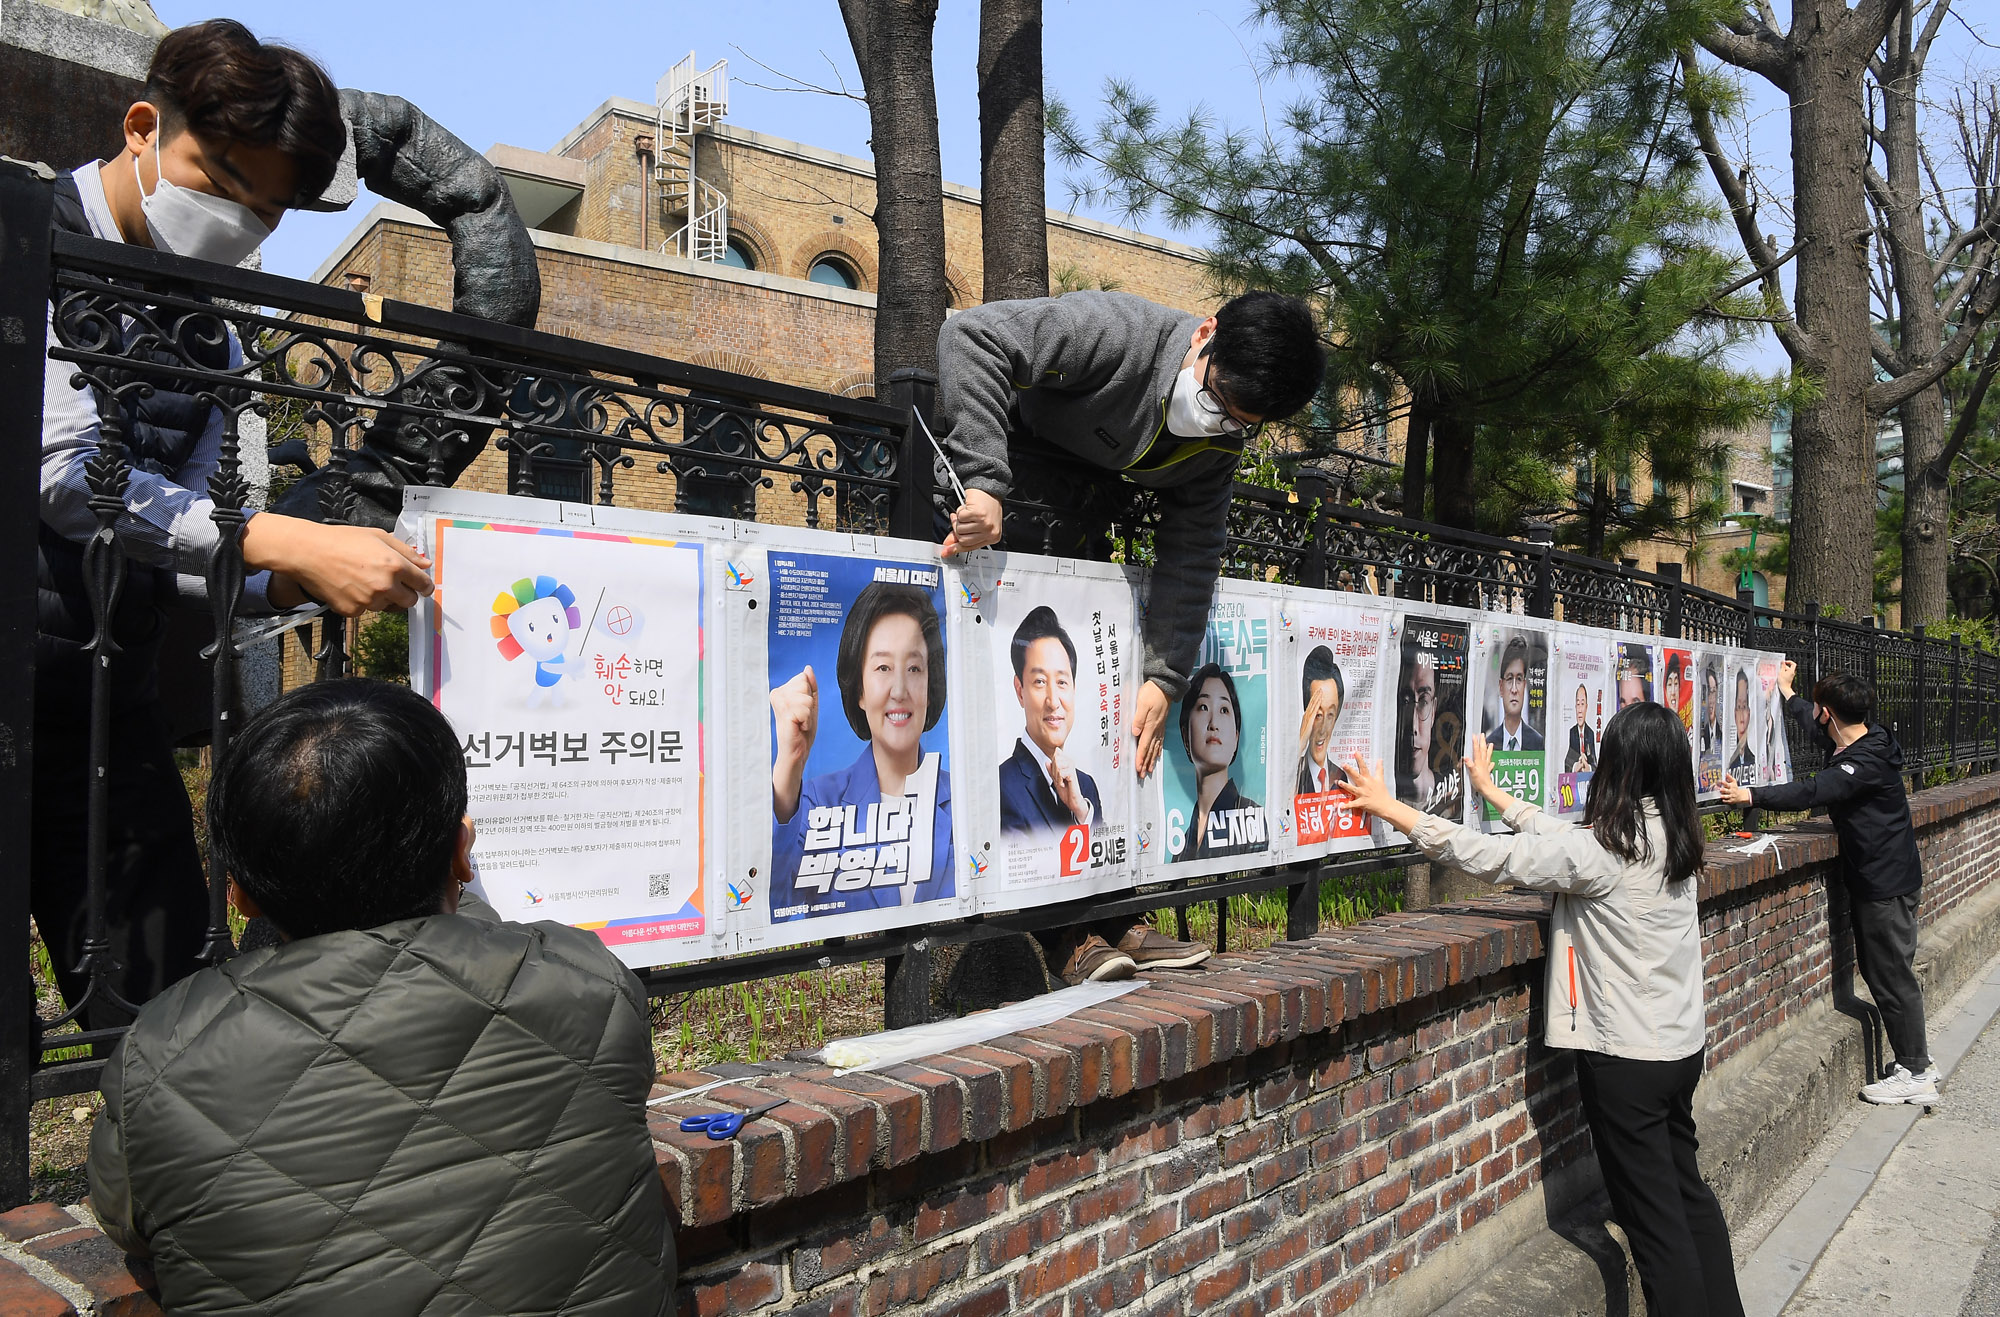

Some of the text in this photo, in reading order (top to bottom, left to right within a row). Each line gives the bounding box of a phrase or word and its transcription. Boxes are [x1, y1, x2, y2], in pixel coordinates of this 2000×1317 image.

[873, 566, 910, 584] 서울시
[1308, 626, 1379, 644] 국가에 돈이 없는 것이 아니라
[1416, 630, 1439, 648] 서울은
[1107, 623, 1121, 687] 서울부터
[1335, 643, 1377, 657] 도둑놈이 많습니다
[594, 652, 663, 680] 훼손하면
[1417, 652, 1439, 670] 이기는
[1092, 610, 1109, 748] 첫날부터 능숙하게
[604, 684, 665, 706] 안 돼요!
[463, 729, 684, 768] 선거벽보 주의문
[474, 783, 508, 792] 선거벽보는
[551, 781, 559, 789] 제
[559, 780, 579, 789] 64조의
[580, 779, 599, 788] 규정에
[600, 778, 619, 787] 의하여
[620, 777, 644, 786] 후보자가
[1528, 768, 1540, 801] 9
[541, 790, 569, 800] 것입니다.
[1561, 784, 1575, 808] 10
[485, 815, 512, 825] 이유없이
[513, 814, 546, 824] 선거벽보를
[583, 812, 595, 820] 자는
[634, 809, 641, 817] 제
[641, 808, 664, 817] 240조의
[664, 807, 682, 816] 규정에
[485, 826, 497, 835] 2년
[497, 825, 518, 834] 이하의
[519, 824, 533, 834] 징역
[533, 824, 547, 832] 또는
[548, 823, 573, 832] 400만원
[574, 821, 593, 830] 이하의
[638, 818, 651, 827] 받게
[1166, 808, 1186, 855] 6
[1207, 805, 1266, 849] 신지혜
[511, 849, 538, 858] 아니하는
[538, 846, 570, 856] 선거벽보는
[570, 844, 583, 853] 해당
[583, 843, 608, 853] 후보자가
[609, 842, 633, 851] 제출하지
[633, 840, 658, 849] 아니하여
[1069, 828, 1085, 873] 2
[1090, 837, 1126, 869] 오세훈
[794, 842, 911, 893] 박영선
[548, 886, 620, 902] 서울특별시선거관리위원회
[622, 927, 645, 938] 아름다운
[659, 924, 676, 934] 행복한
[677, 921, 700, 932] 대한민국
